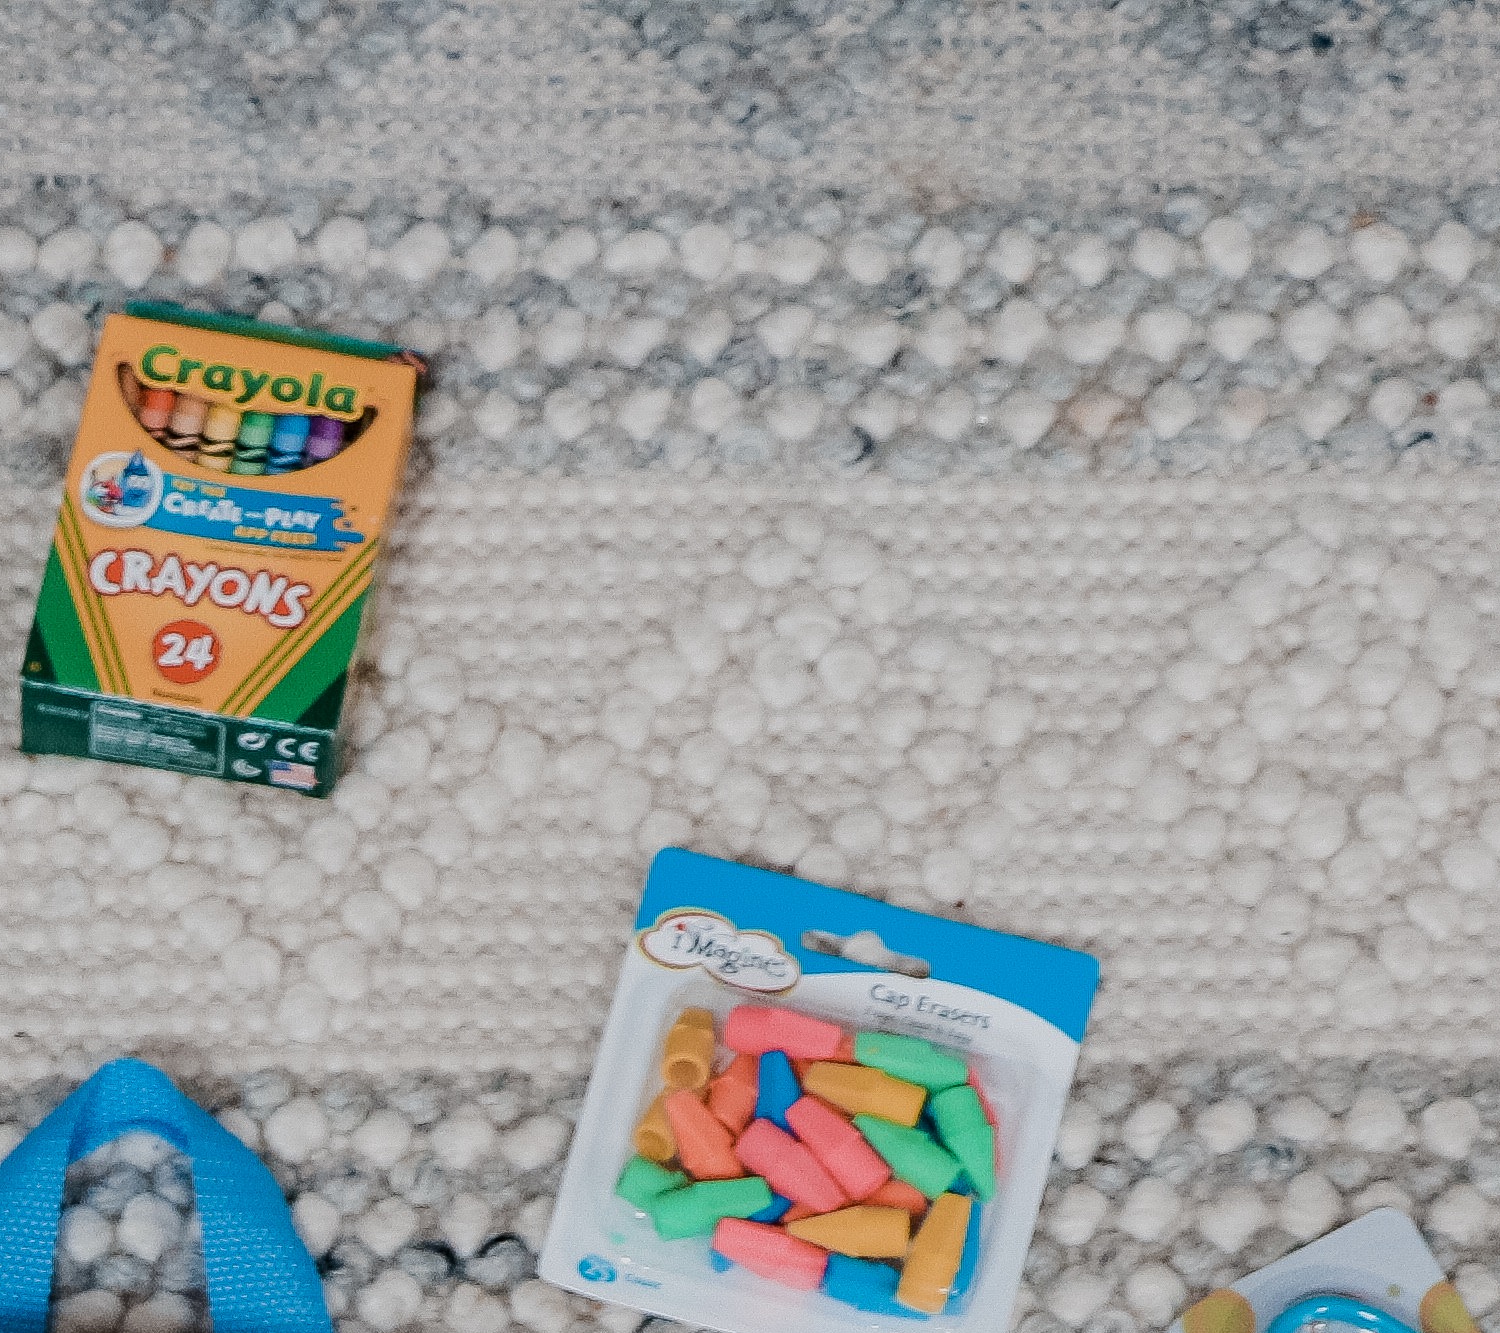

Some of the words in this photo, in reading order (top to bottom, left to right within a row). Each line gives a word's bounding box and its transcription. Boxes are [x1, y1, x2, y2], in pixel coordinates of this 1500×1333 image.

[141, 345, 358, 413] Crayola
[90, 549, 311, 628] CRAYONS
[157, 633, 215, 671] 24
[870, 983, 910, 1009] Cap
[915, 995, 992, 1030] Erasers
